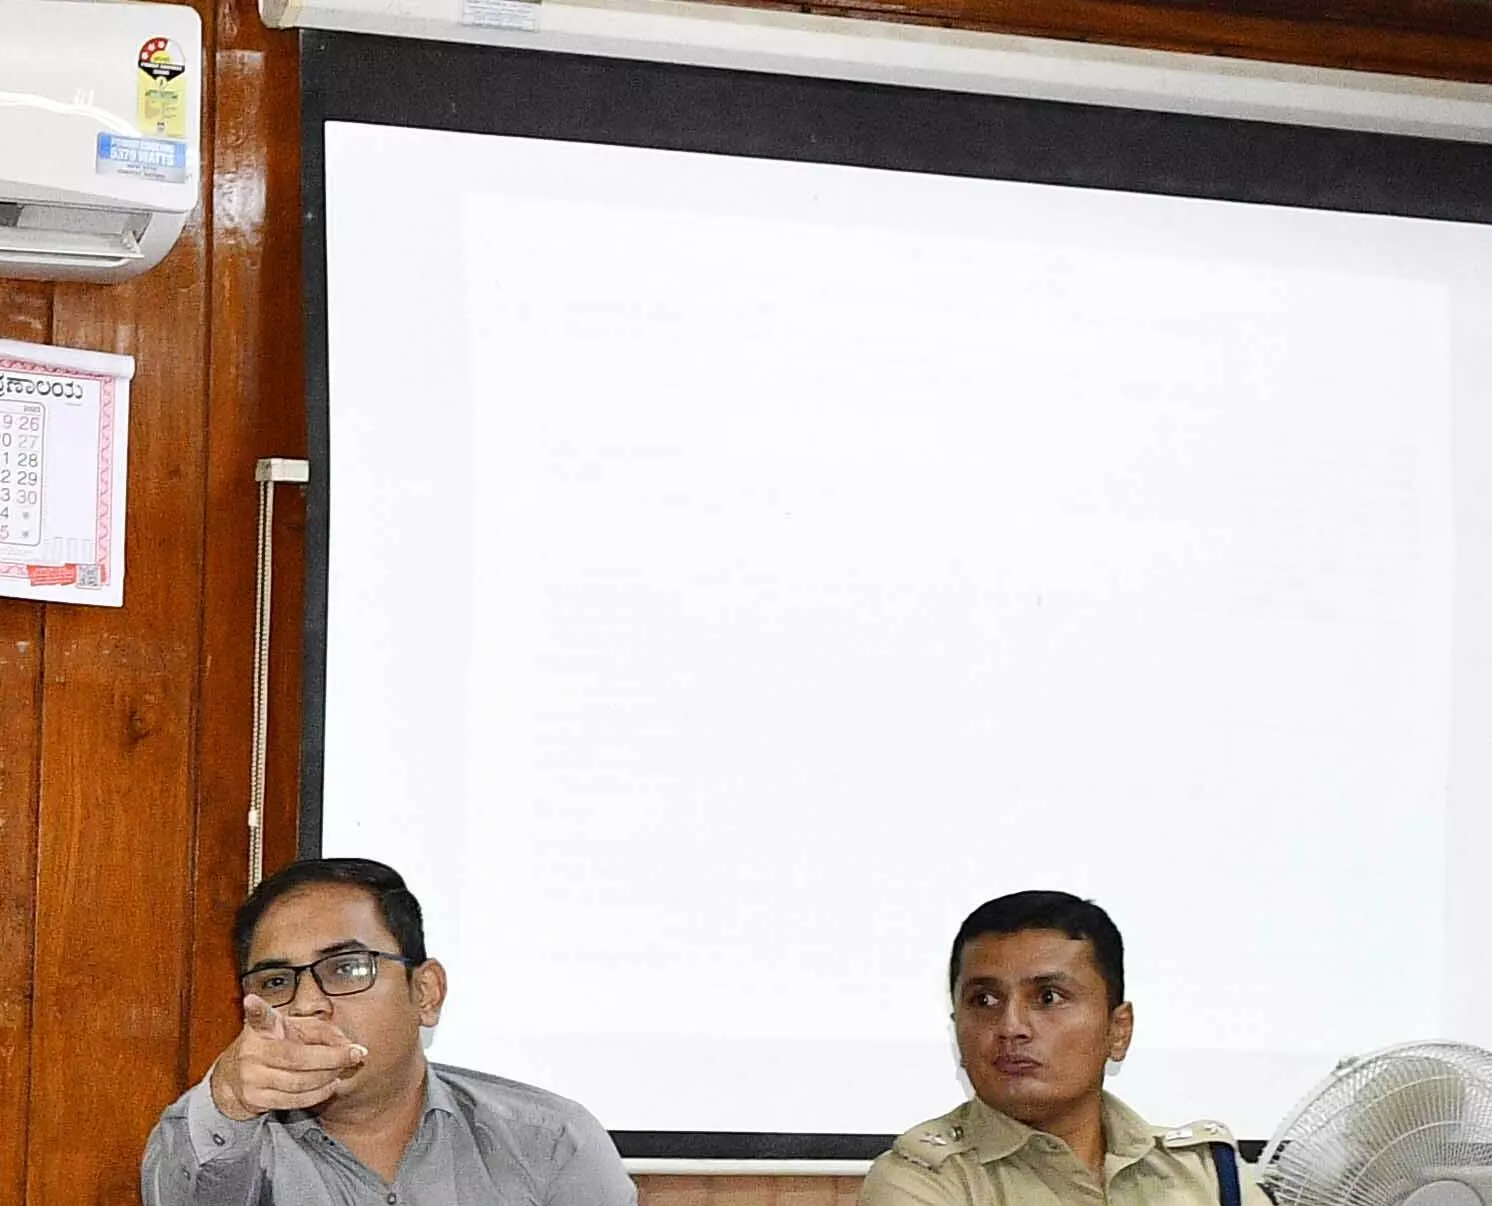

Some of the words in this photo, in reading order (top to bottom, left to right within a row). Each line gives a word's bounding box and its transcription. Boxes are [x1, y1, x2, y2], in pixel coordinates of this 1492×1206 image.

[19, 416, 40, 432] 26
[18, 434, 39, 450] 27
[18, 453, 38, 468] 28
[17, 471, 38, 486] 29
[16, 490, 38, 505] 30
